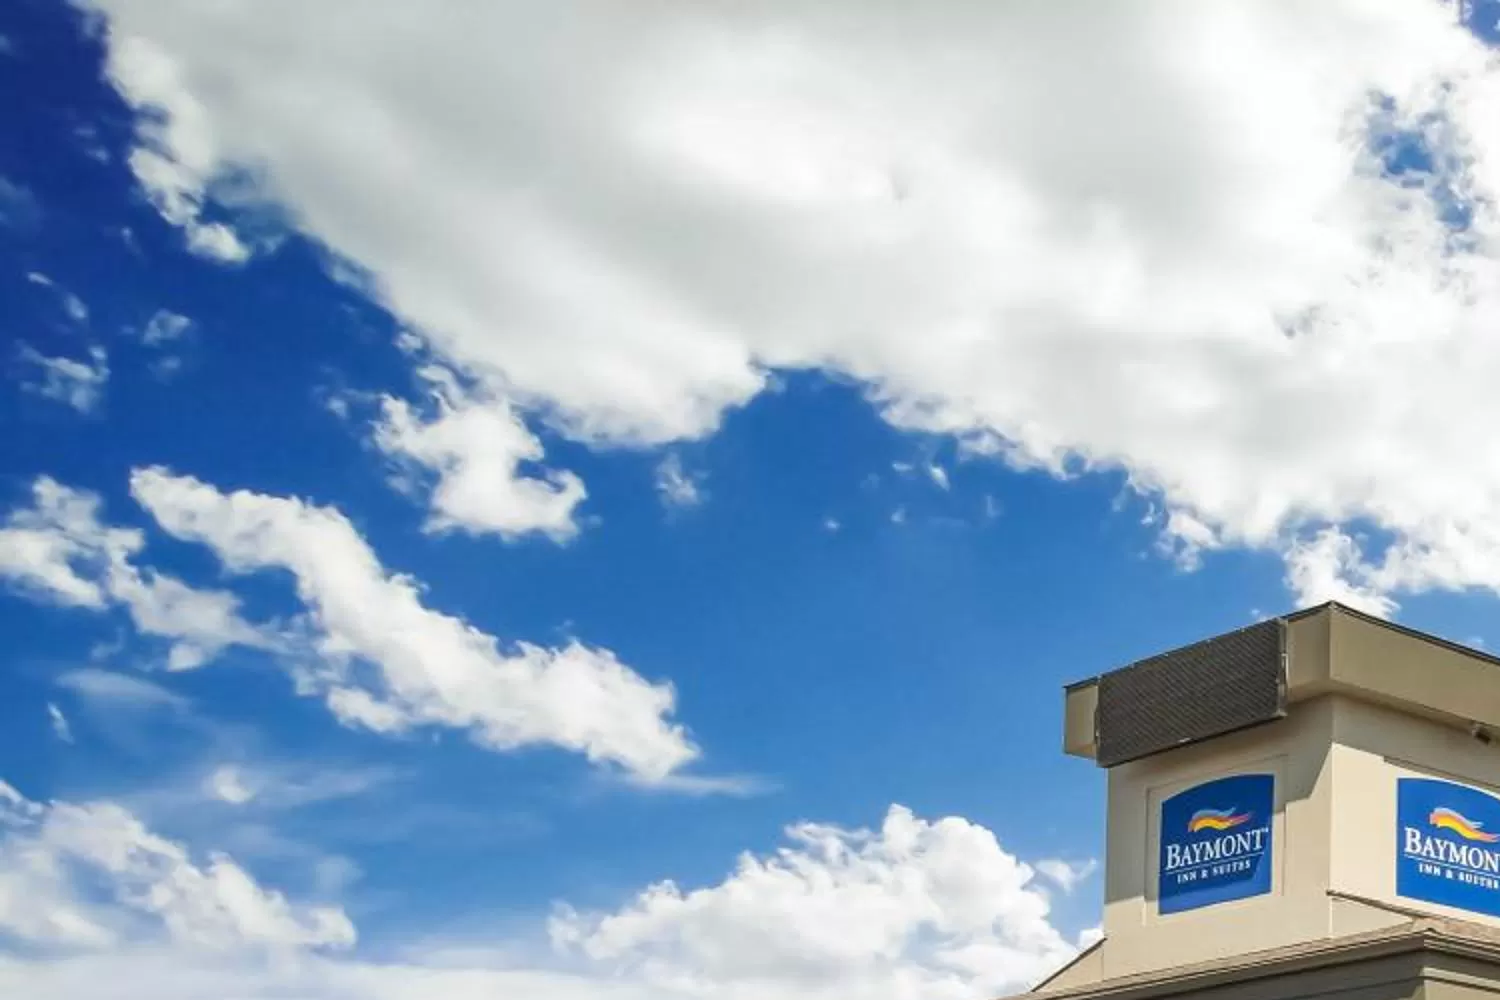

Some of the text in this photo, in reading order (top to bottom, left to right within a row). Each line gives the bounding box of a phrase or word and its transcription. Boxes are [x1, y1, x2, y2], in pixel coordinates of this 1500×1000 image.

[1165, 829, 1264, 871] BAYMONT
[1177, 870, 1197, 884] INN
[1213, 859, 1251, 876] SUITES
[1418, 863, 1441, 876] INN
[1458, 870, 1499, 889] SUITES
